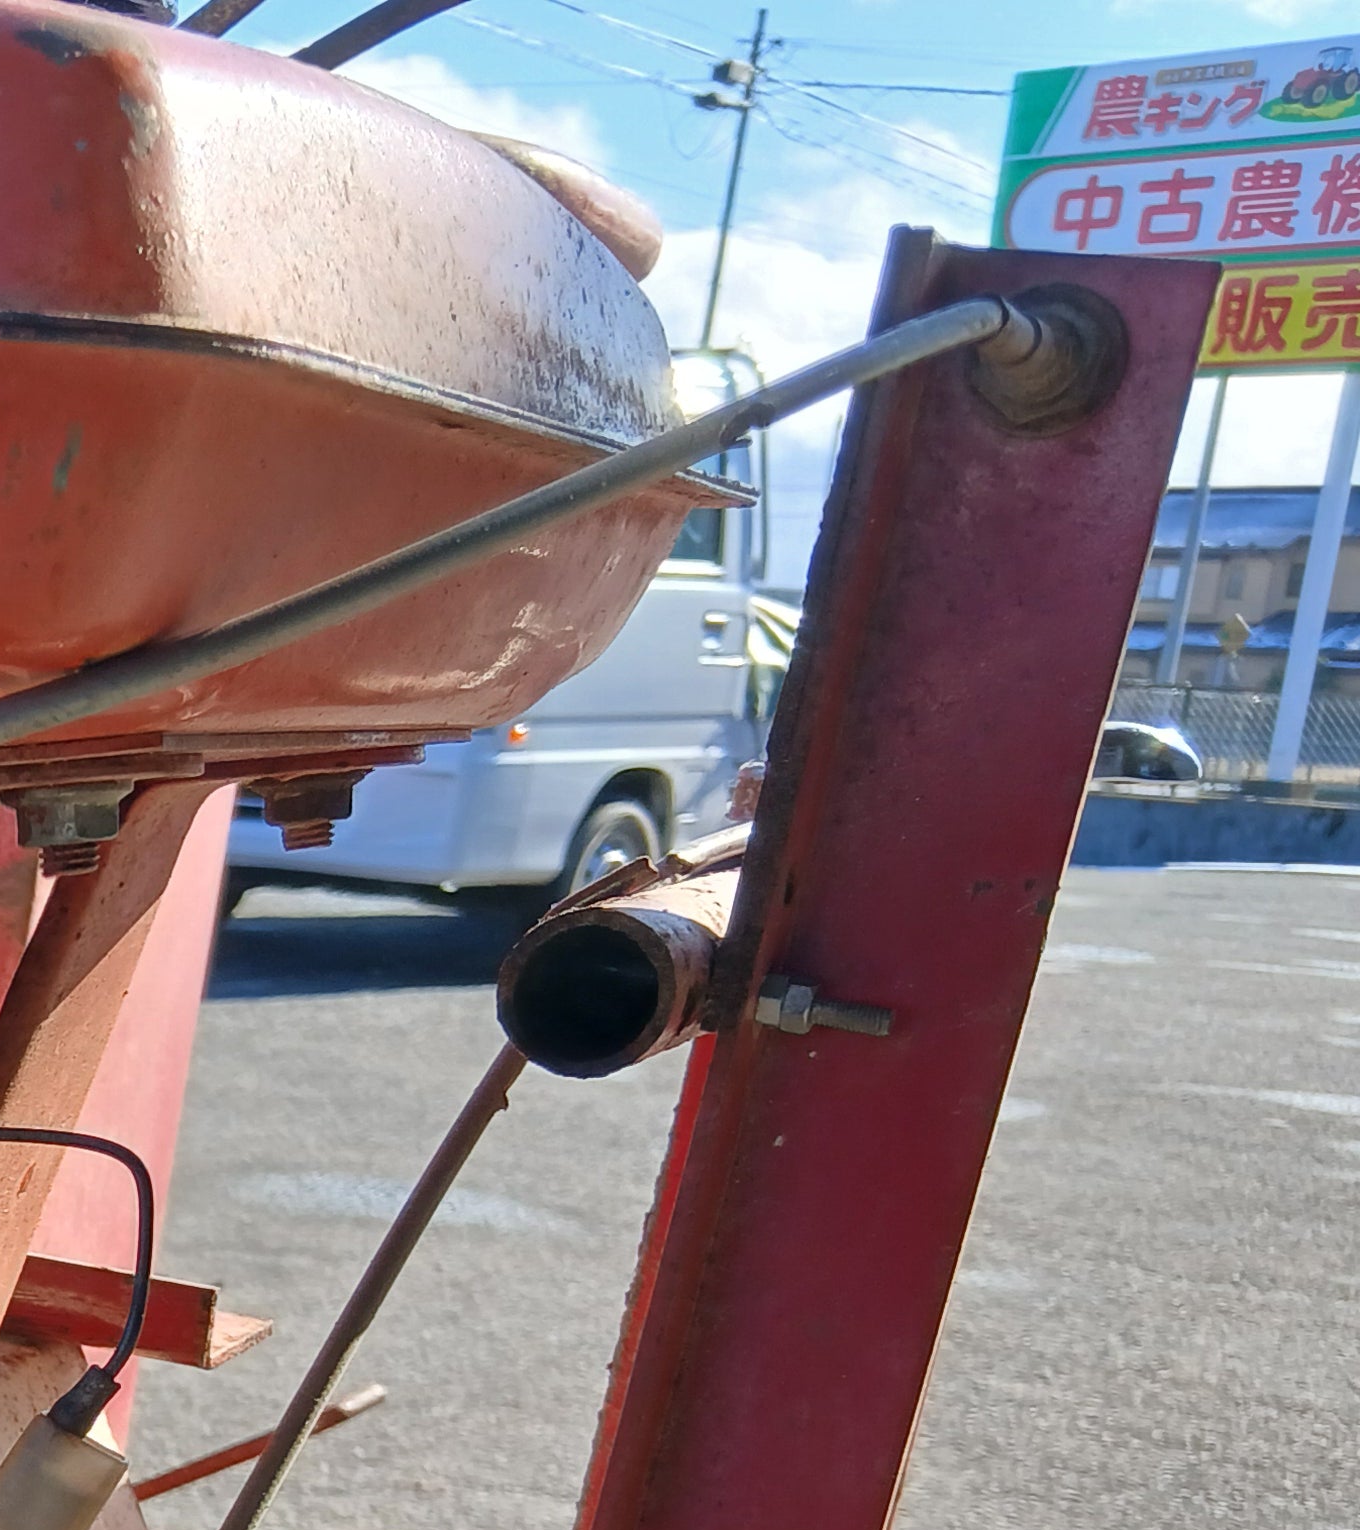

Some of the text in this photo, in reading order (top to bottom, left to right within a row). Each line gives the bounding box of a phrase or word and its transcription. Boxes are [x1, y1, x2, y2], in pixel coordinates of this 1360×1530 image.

[1084, 76, 1266, 141] 農キング
[1053, 154, 1360, 250] 中古農機
[1211, 270, 1360, 354] 販売
